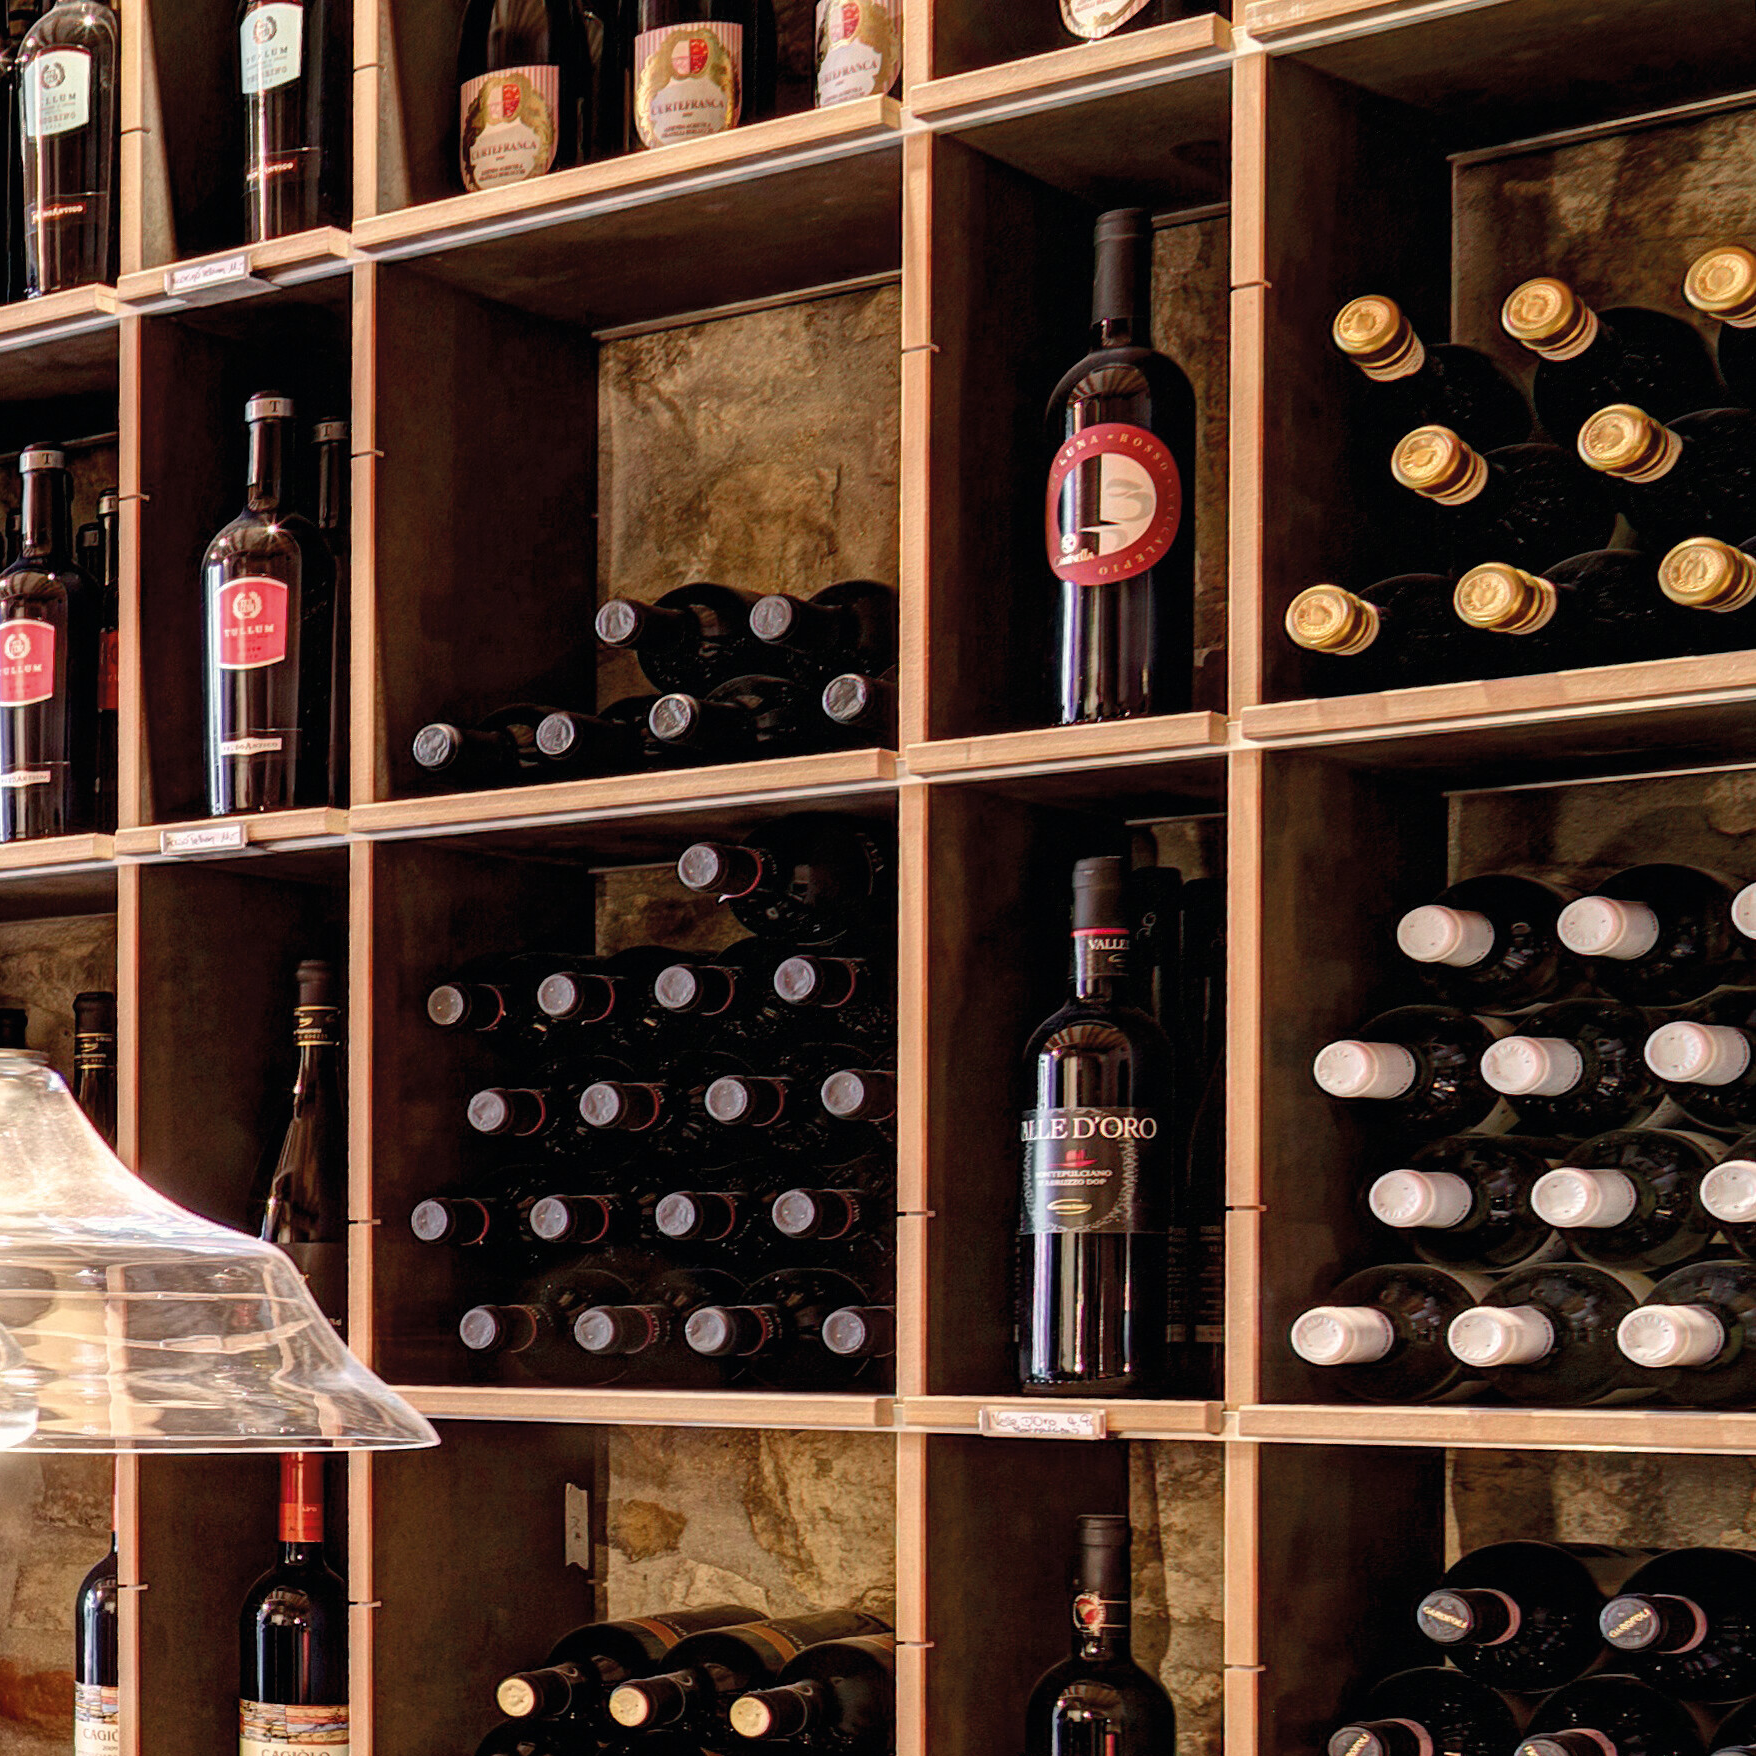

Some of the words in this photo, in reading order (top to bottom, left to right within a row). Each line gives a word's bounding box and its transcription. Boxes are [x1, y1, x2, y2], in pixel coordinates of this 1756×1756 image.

[1119, 433, 1170, 471] ROSSO
[223, 623, 275, 639] TULLUM
[1071, 1116, 1157, 1140] D'ORO
